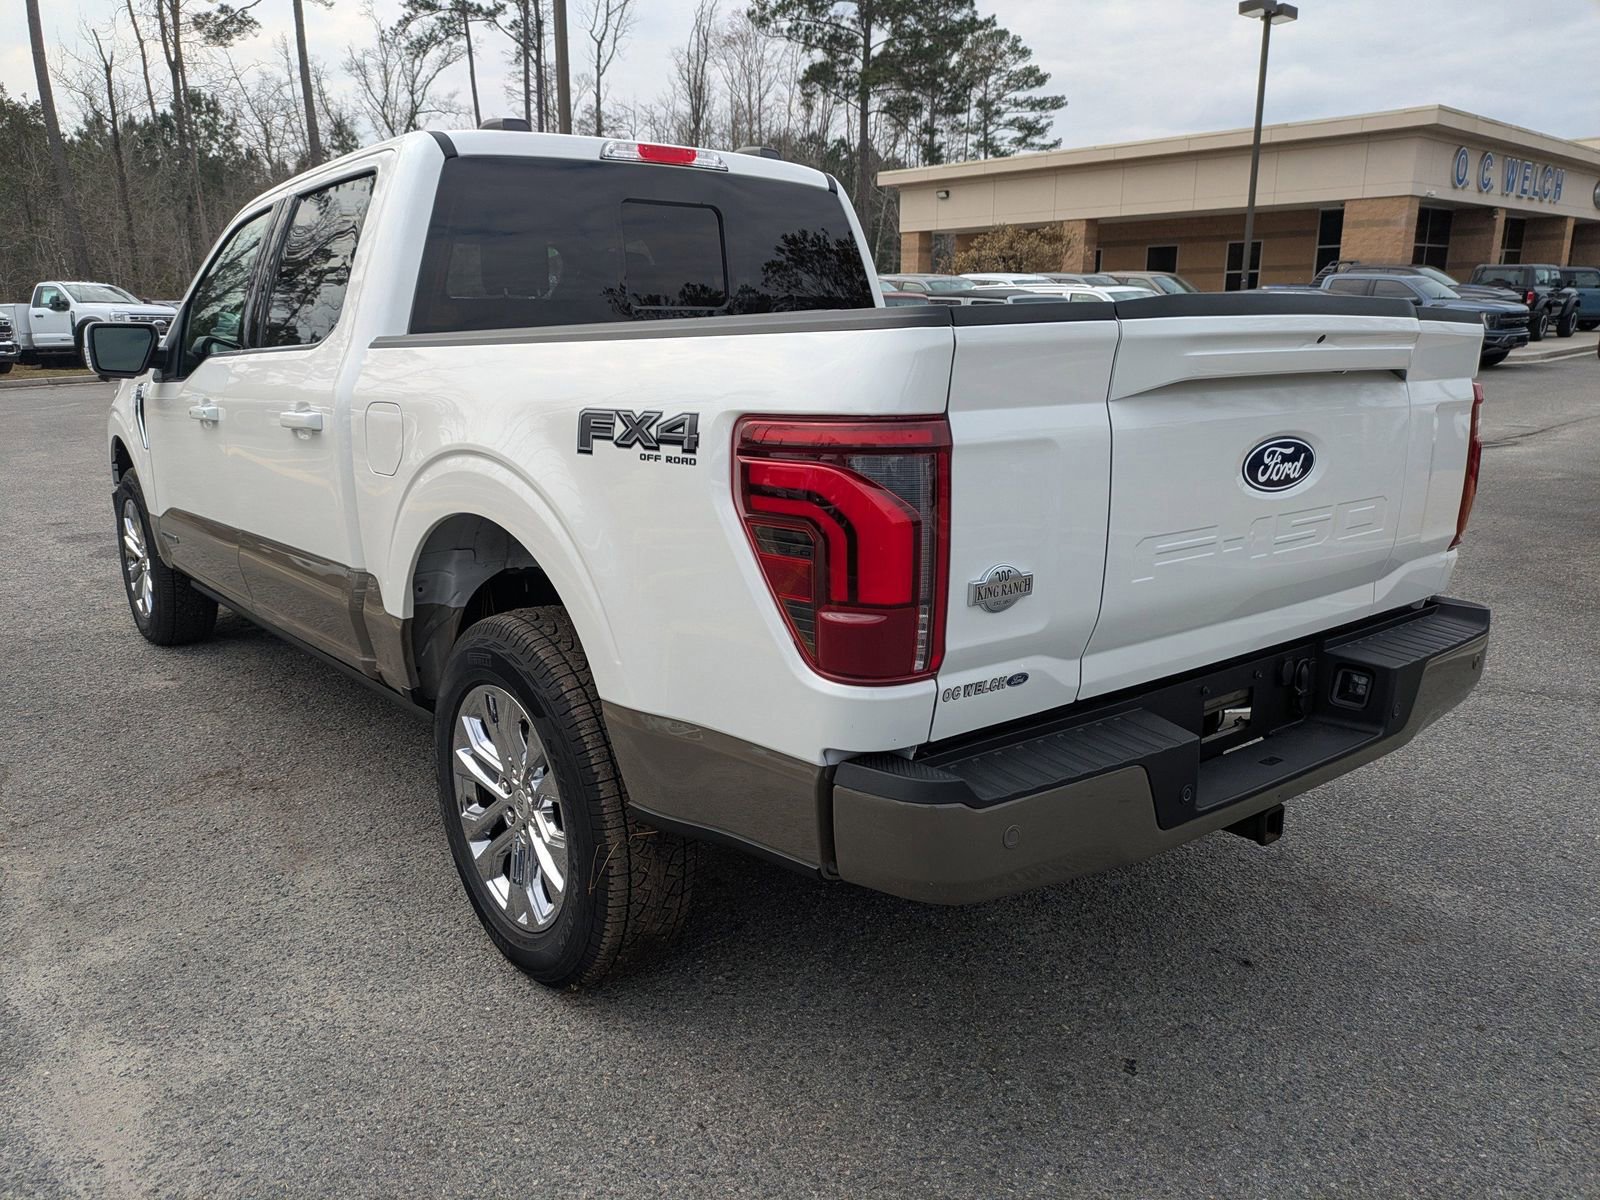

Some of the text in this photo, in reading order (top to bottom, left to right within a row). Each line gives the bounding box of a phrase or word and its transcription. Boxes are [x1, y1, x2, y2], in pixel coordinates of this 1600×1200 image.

[1503, 157, 1565, 203] WELCH
[577, 407, 700, 455] FX4
[639, 453, 697, 466] OFF ROAD
[1257, 446, 1305, 482] Ford
[1131, 495, 1388, 583] F-150
[977, 577, 1031, 601] KING RANCH
[942, 686, 961, 702] OC
[963, 676, 1007, 698] WELCH
